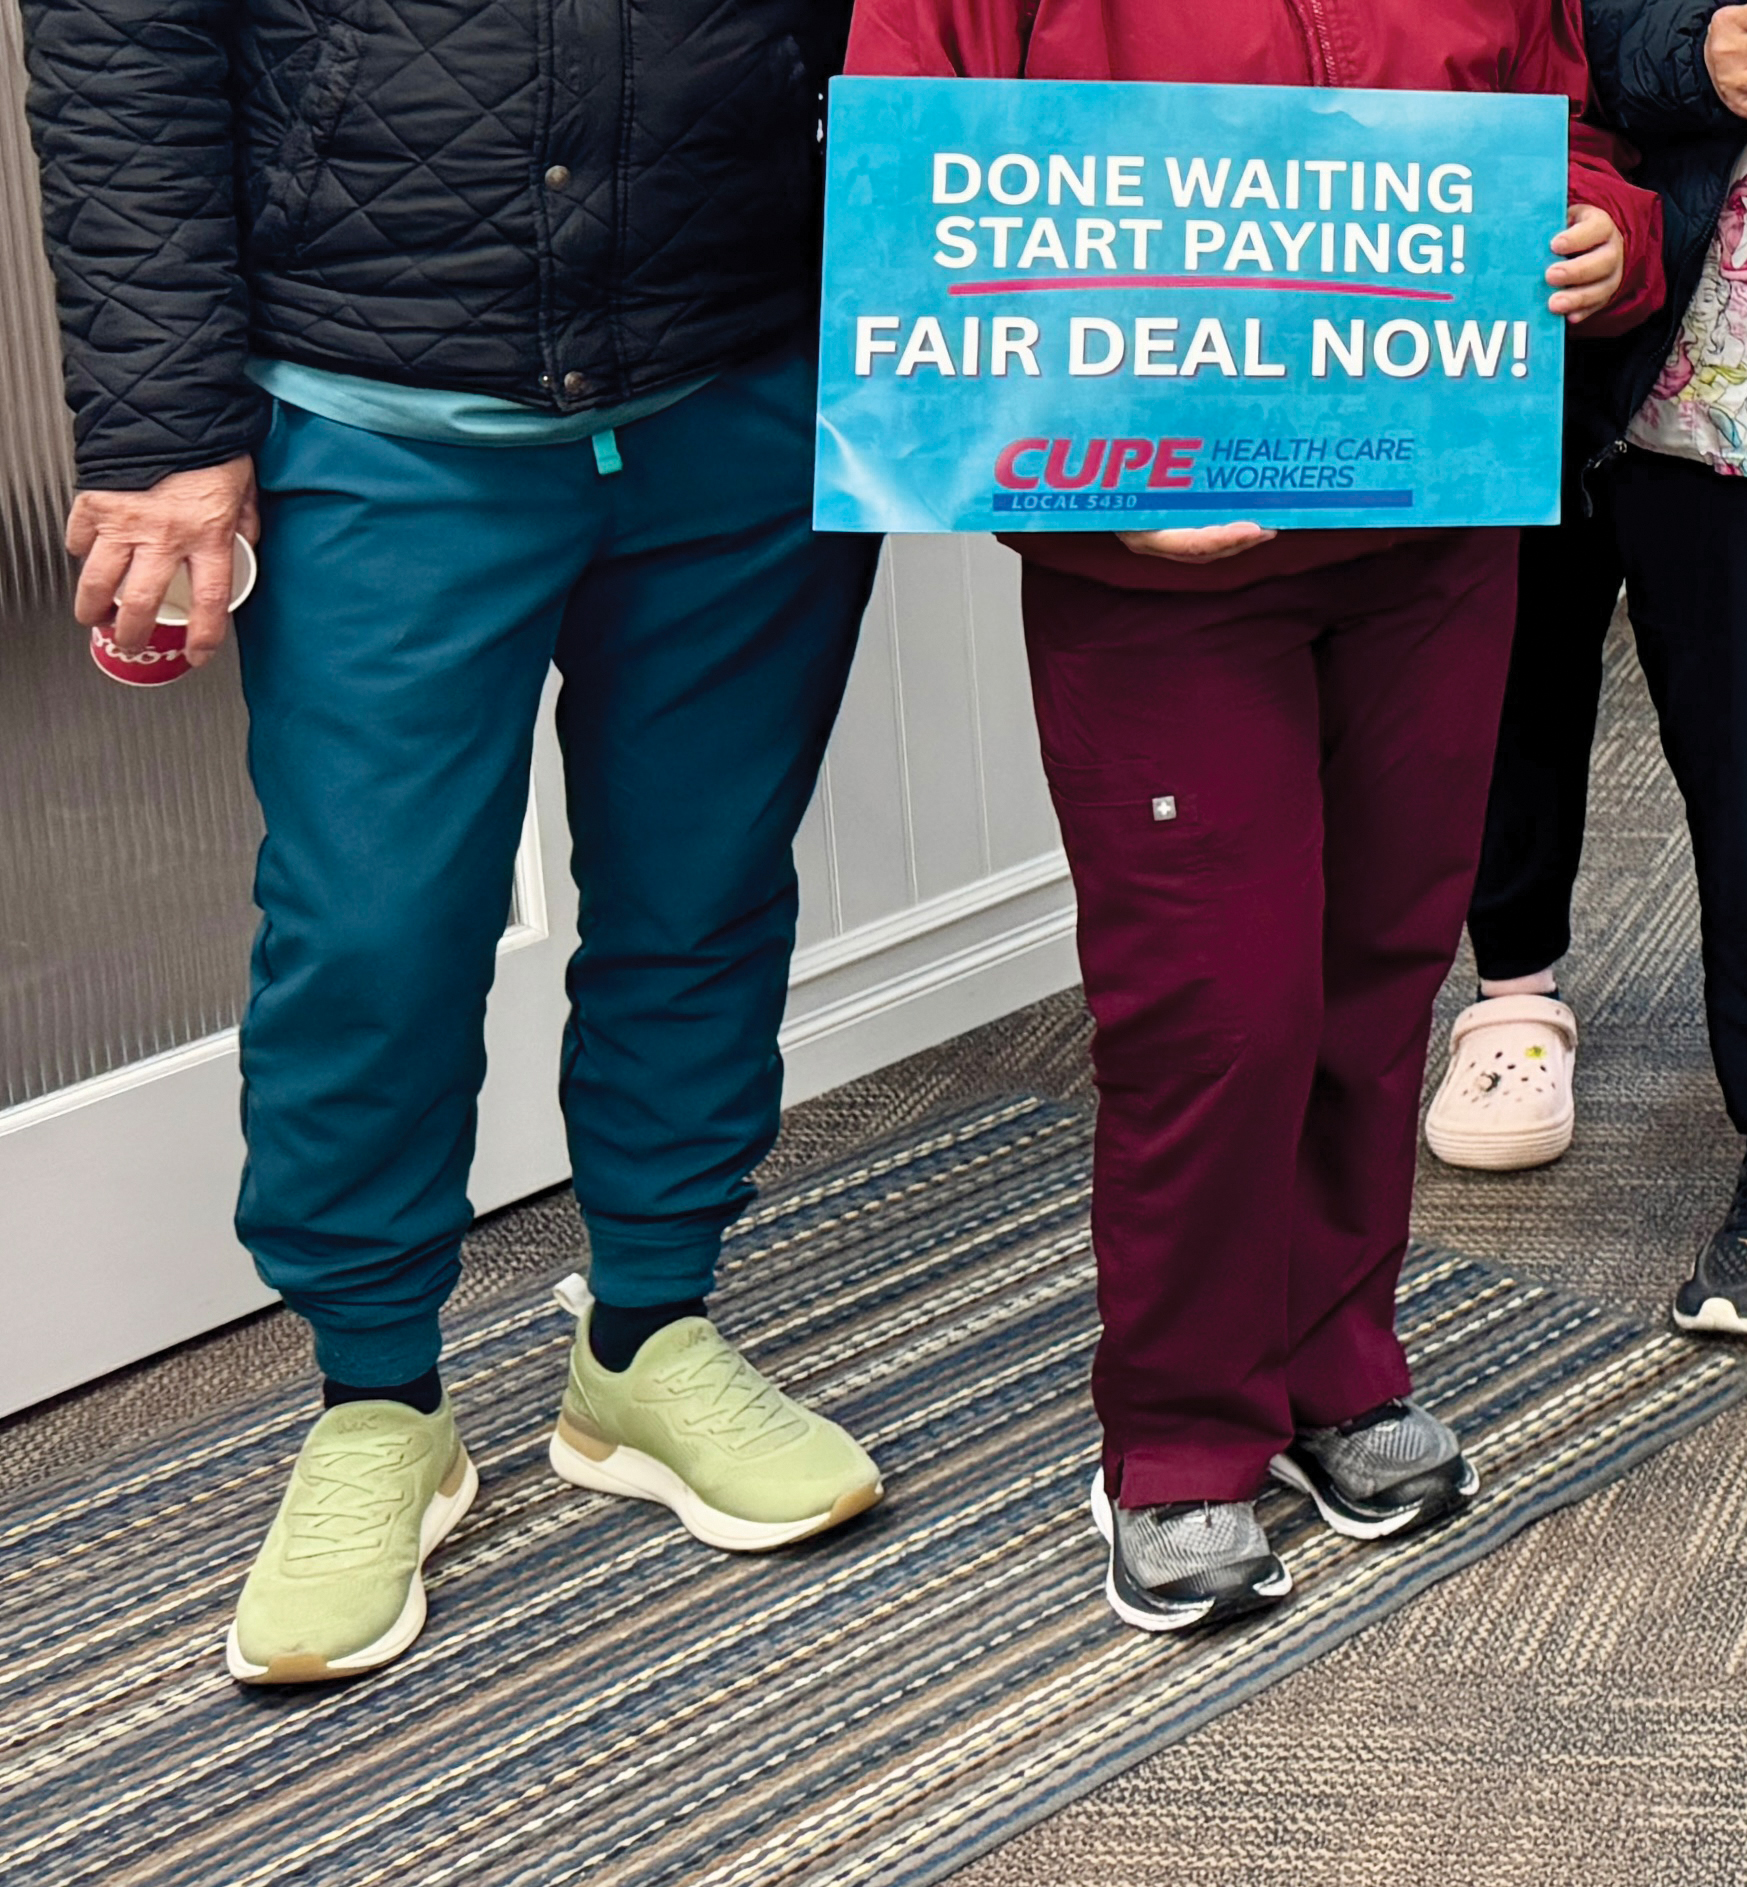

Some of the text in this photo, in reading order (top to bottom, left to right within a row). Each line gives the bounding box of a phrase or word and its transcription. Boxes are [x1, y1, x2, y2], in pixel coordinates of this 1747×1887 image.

[931, 152, 1474, 214] DONE WAITING
[933, 216, 1466, 275] START PAYING!
[854, 315, 1529, 378] FAIR DEAL NOW!
[994, 437, 1204, 489] CUPE
[1211, 438, 1415, 462] HEALTH CARE
[1011, 494, 1138, 509] LOCAL 5430
[1206, 466, 1354, 489] WORKERS
